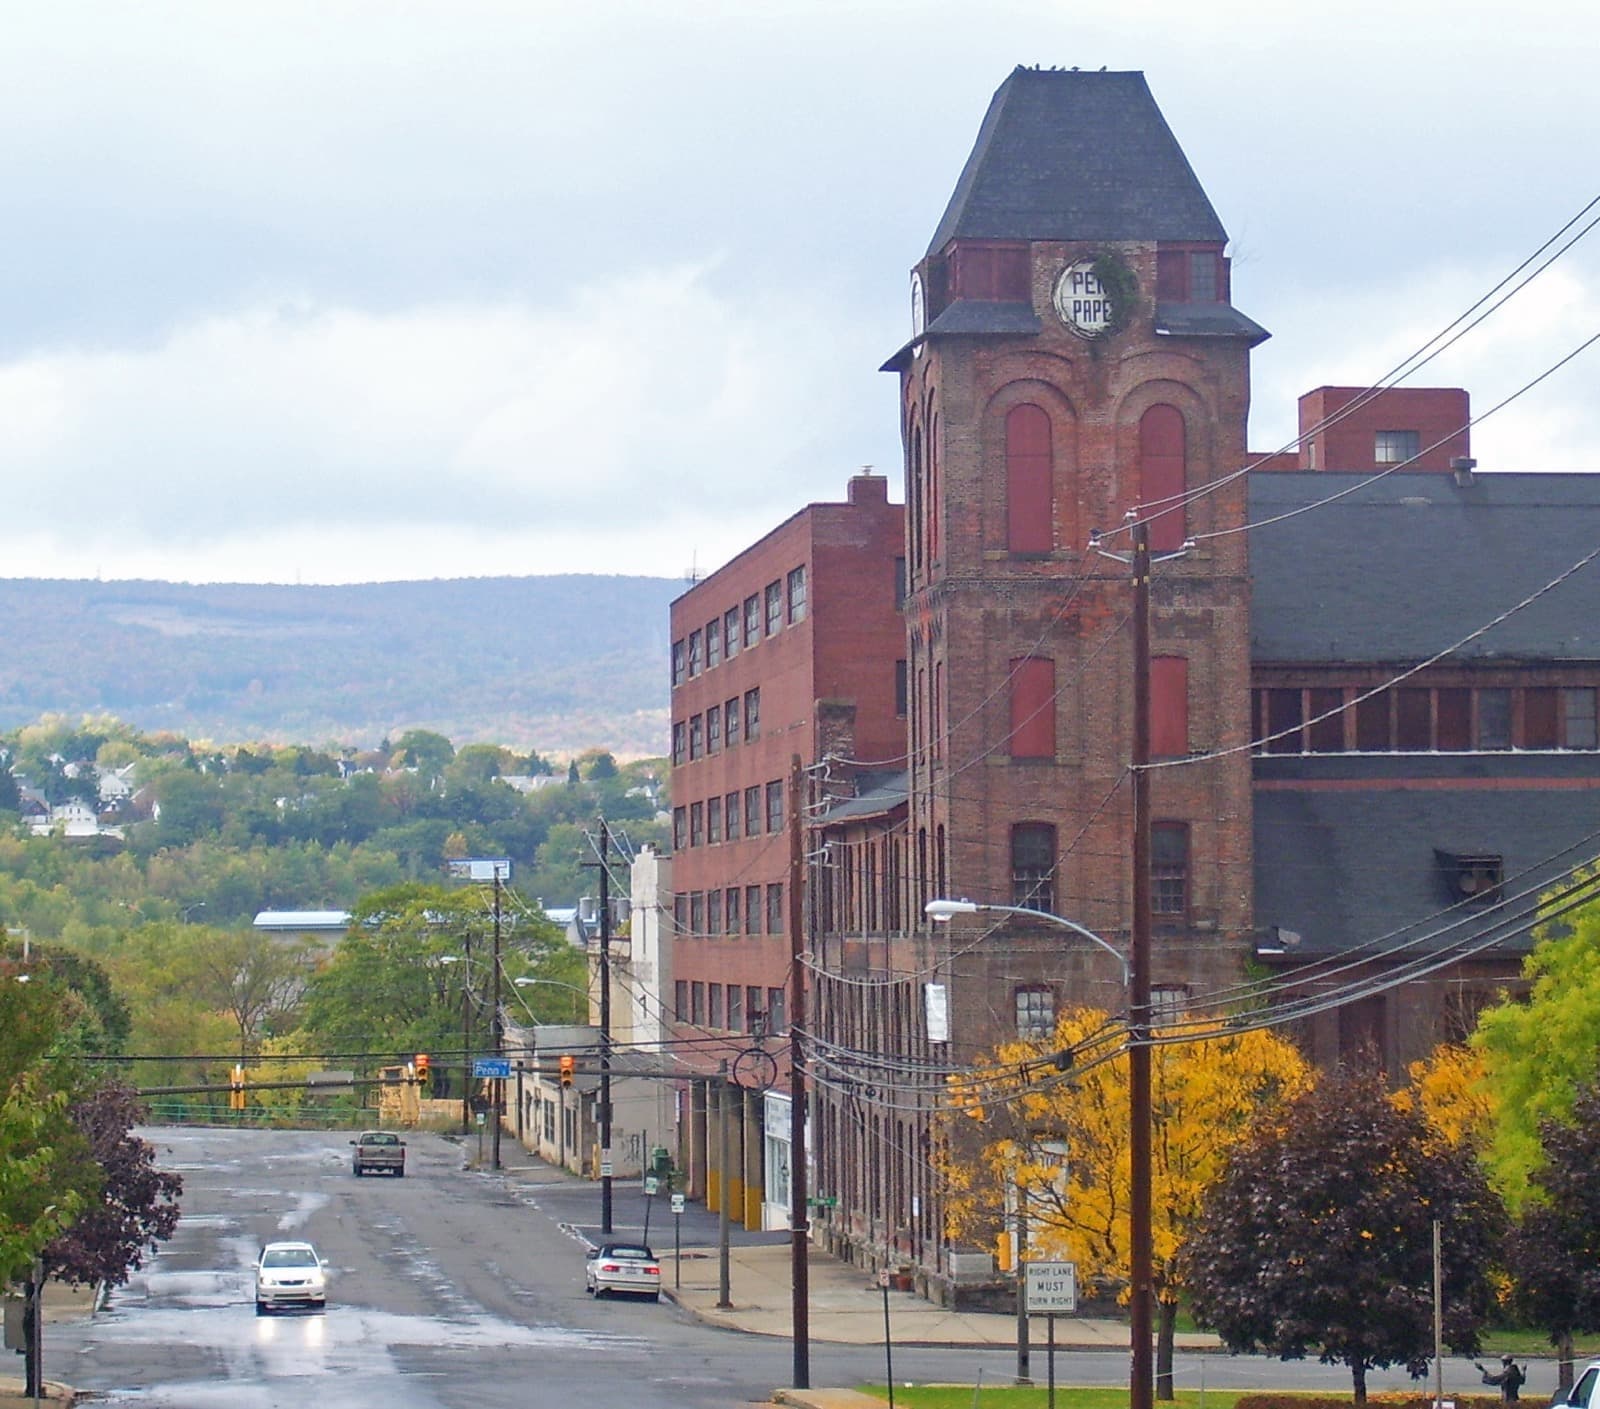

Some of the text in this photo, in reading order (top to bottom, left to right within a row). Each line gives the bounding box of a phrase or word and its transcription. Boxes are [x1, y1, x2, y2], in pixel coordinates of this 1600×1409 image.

[1073, 272, 1107, 294] PEN
[1073, 300, 1111, 322] PAPE
[475, 1065, 500, 1075] Penn
[1029, 1267, 1072, 1276] RIGHT LANE
[1037, 1281, 1064, 1291] MUST
[1028, 1297, 1072, 1305] TURN RIGHT
